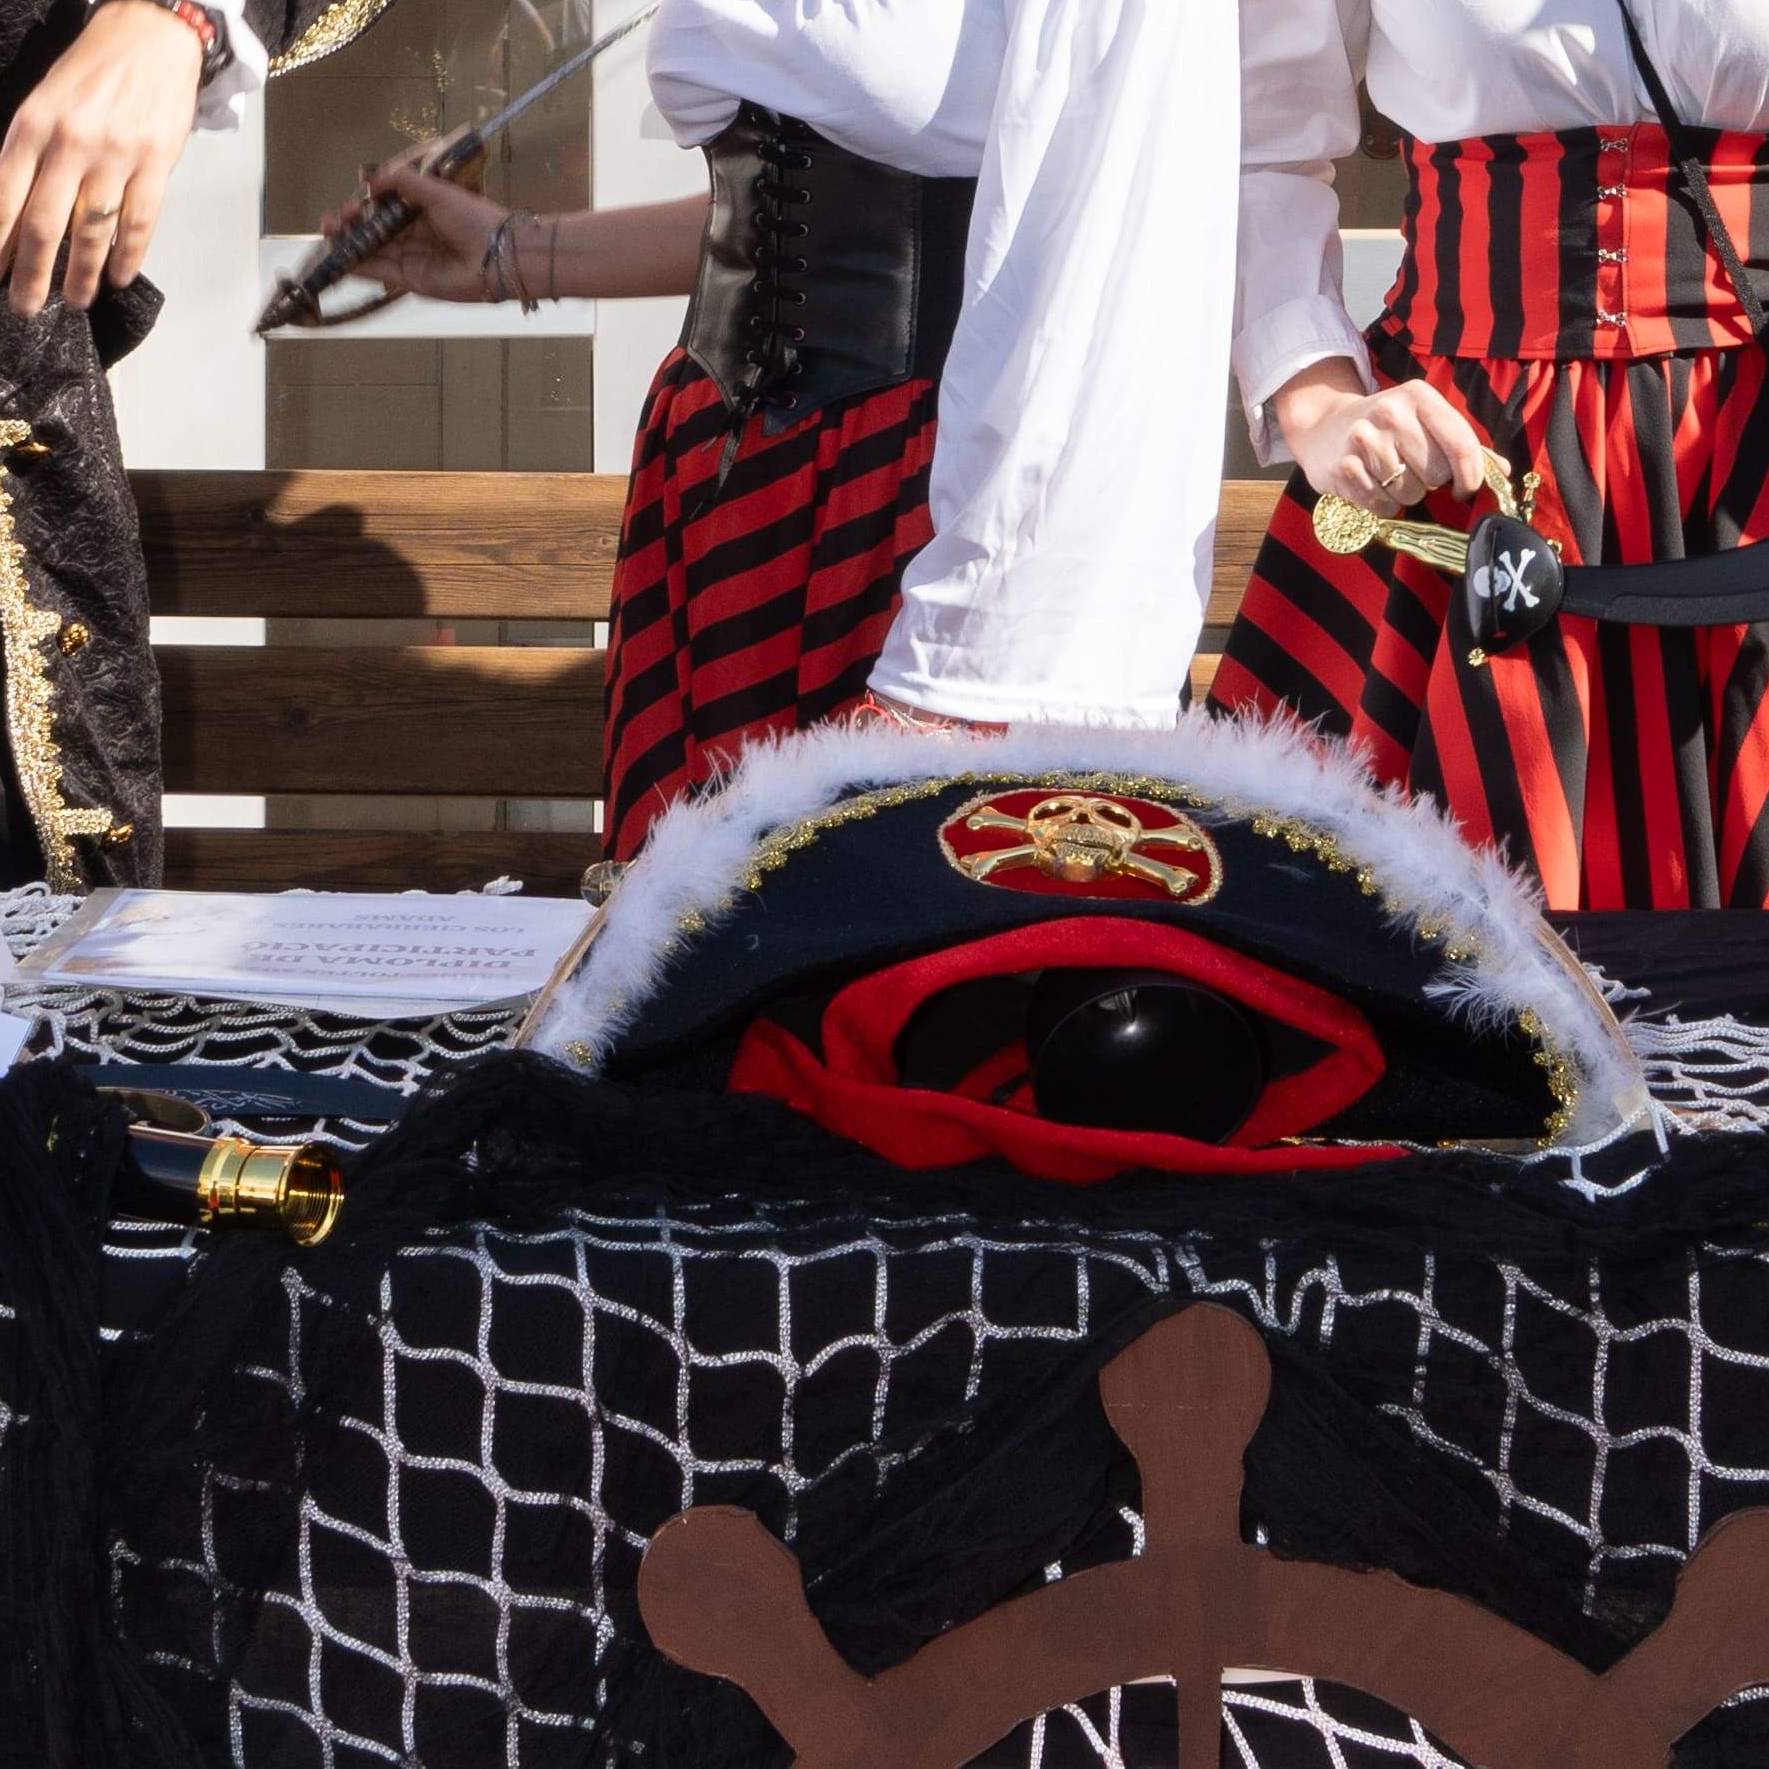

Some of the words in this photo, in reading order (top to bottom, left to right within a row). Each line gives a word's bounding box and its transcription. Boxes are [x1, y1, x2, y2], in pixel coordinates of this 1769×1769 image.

[241, 941, 538, 957] PARTICIPACIÓ
[248, 953, 304, 963] DE
[317, 955, 512, 968] DIPLOMA
